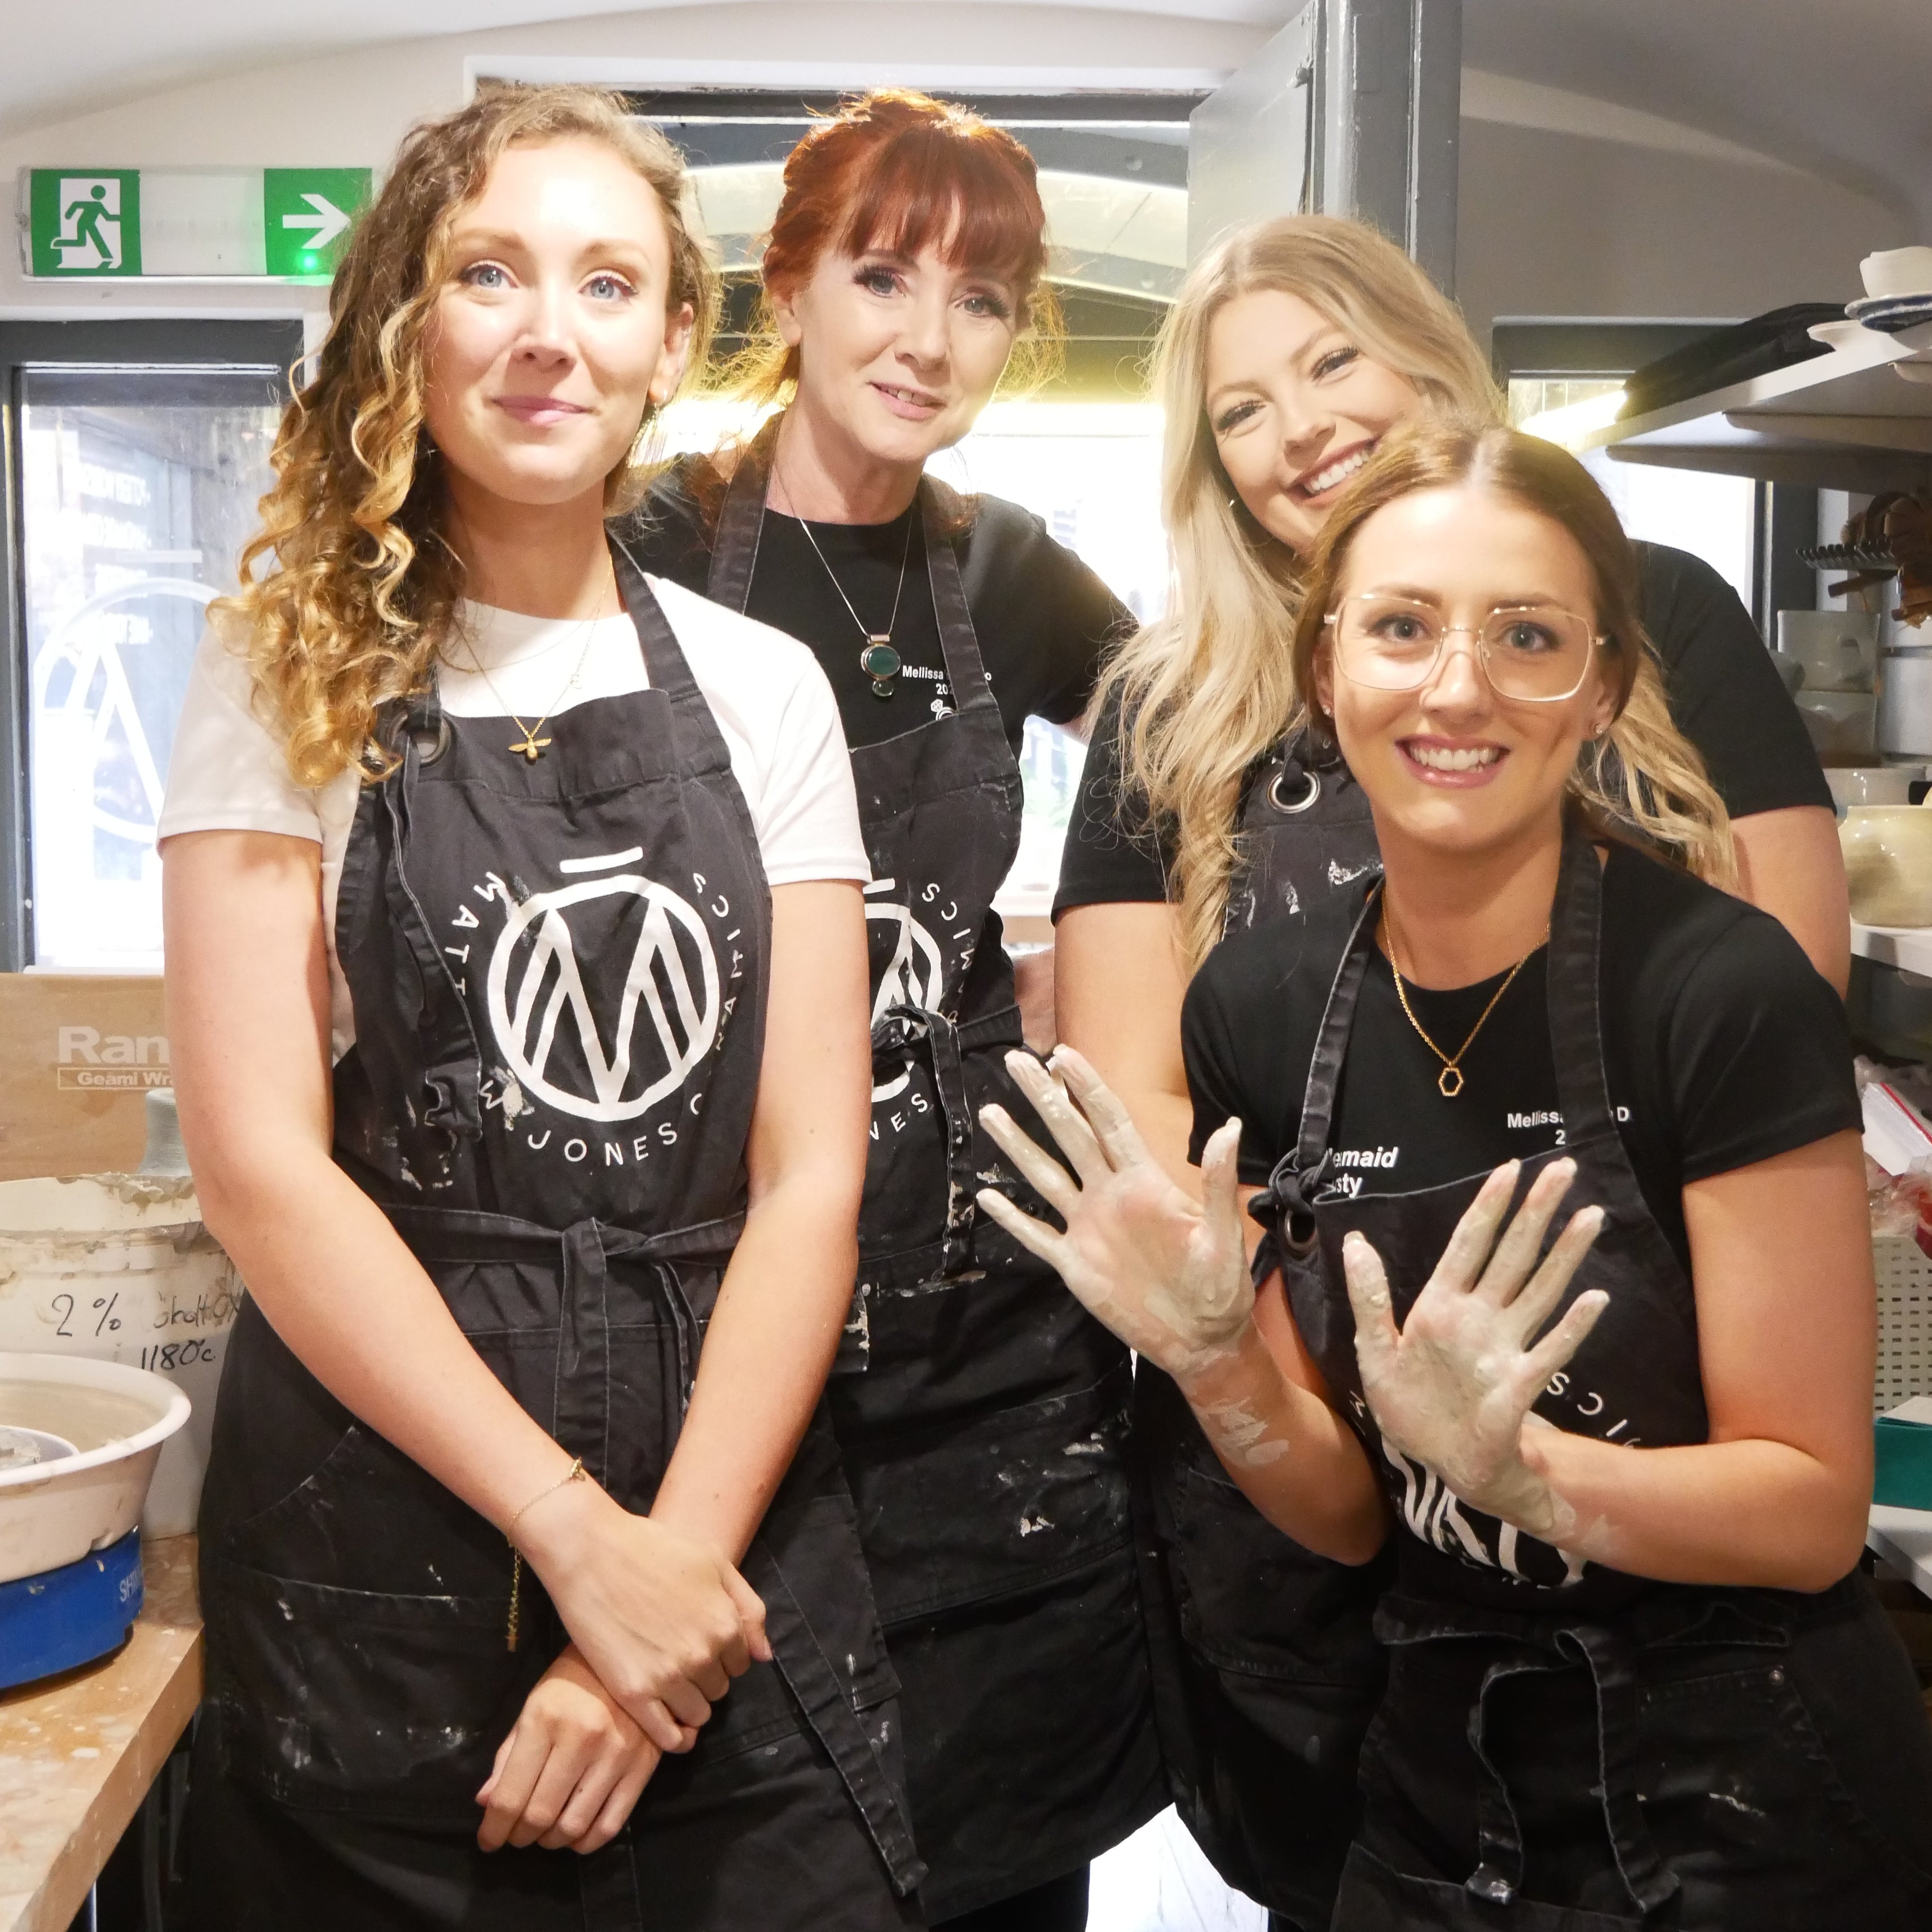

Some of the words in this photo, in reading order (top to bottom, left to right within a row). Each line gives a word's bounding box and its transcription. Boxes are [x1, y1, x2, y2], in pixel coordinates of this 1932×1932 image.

[903, 665, 943, 680] Mellissa
[936, 683, 949, 695] 20
[445, 871, 506, 996] MATT
[528, 1122, 678, 1165] JONES
[690, 872, 744, 1116] CRAMICS
[59, 1025, 169, 1064] Ran
[77, 1072, 138, 1086] Geami
[143, 1072, 172, 1086] Wr
[52, 1294, 74, 1337] 2
